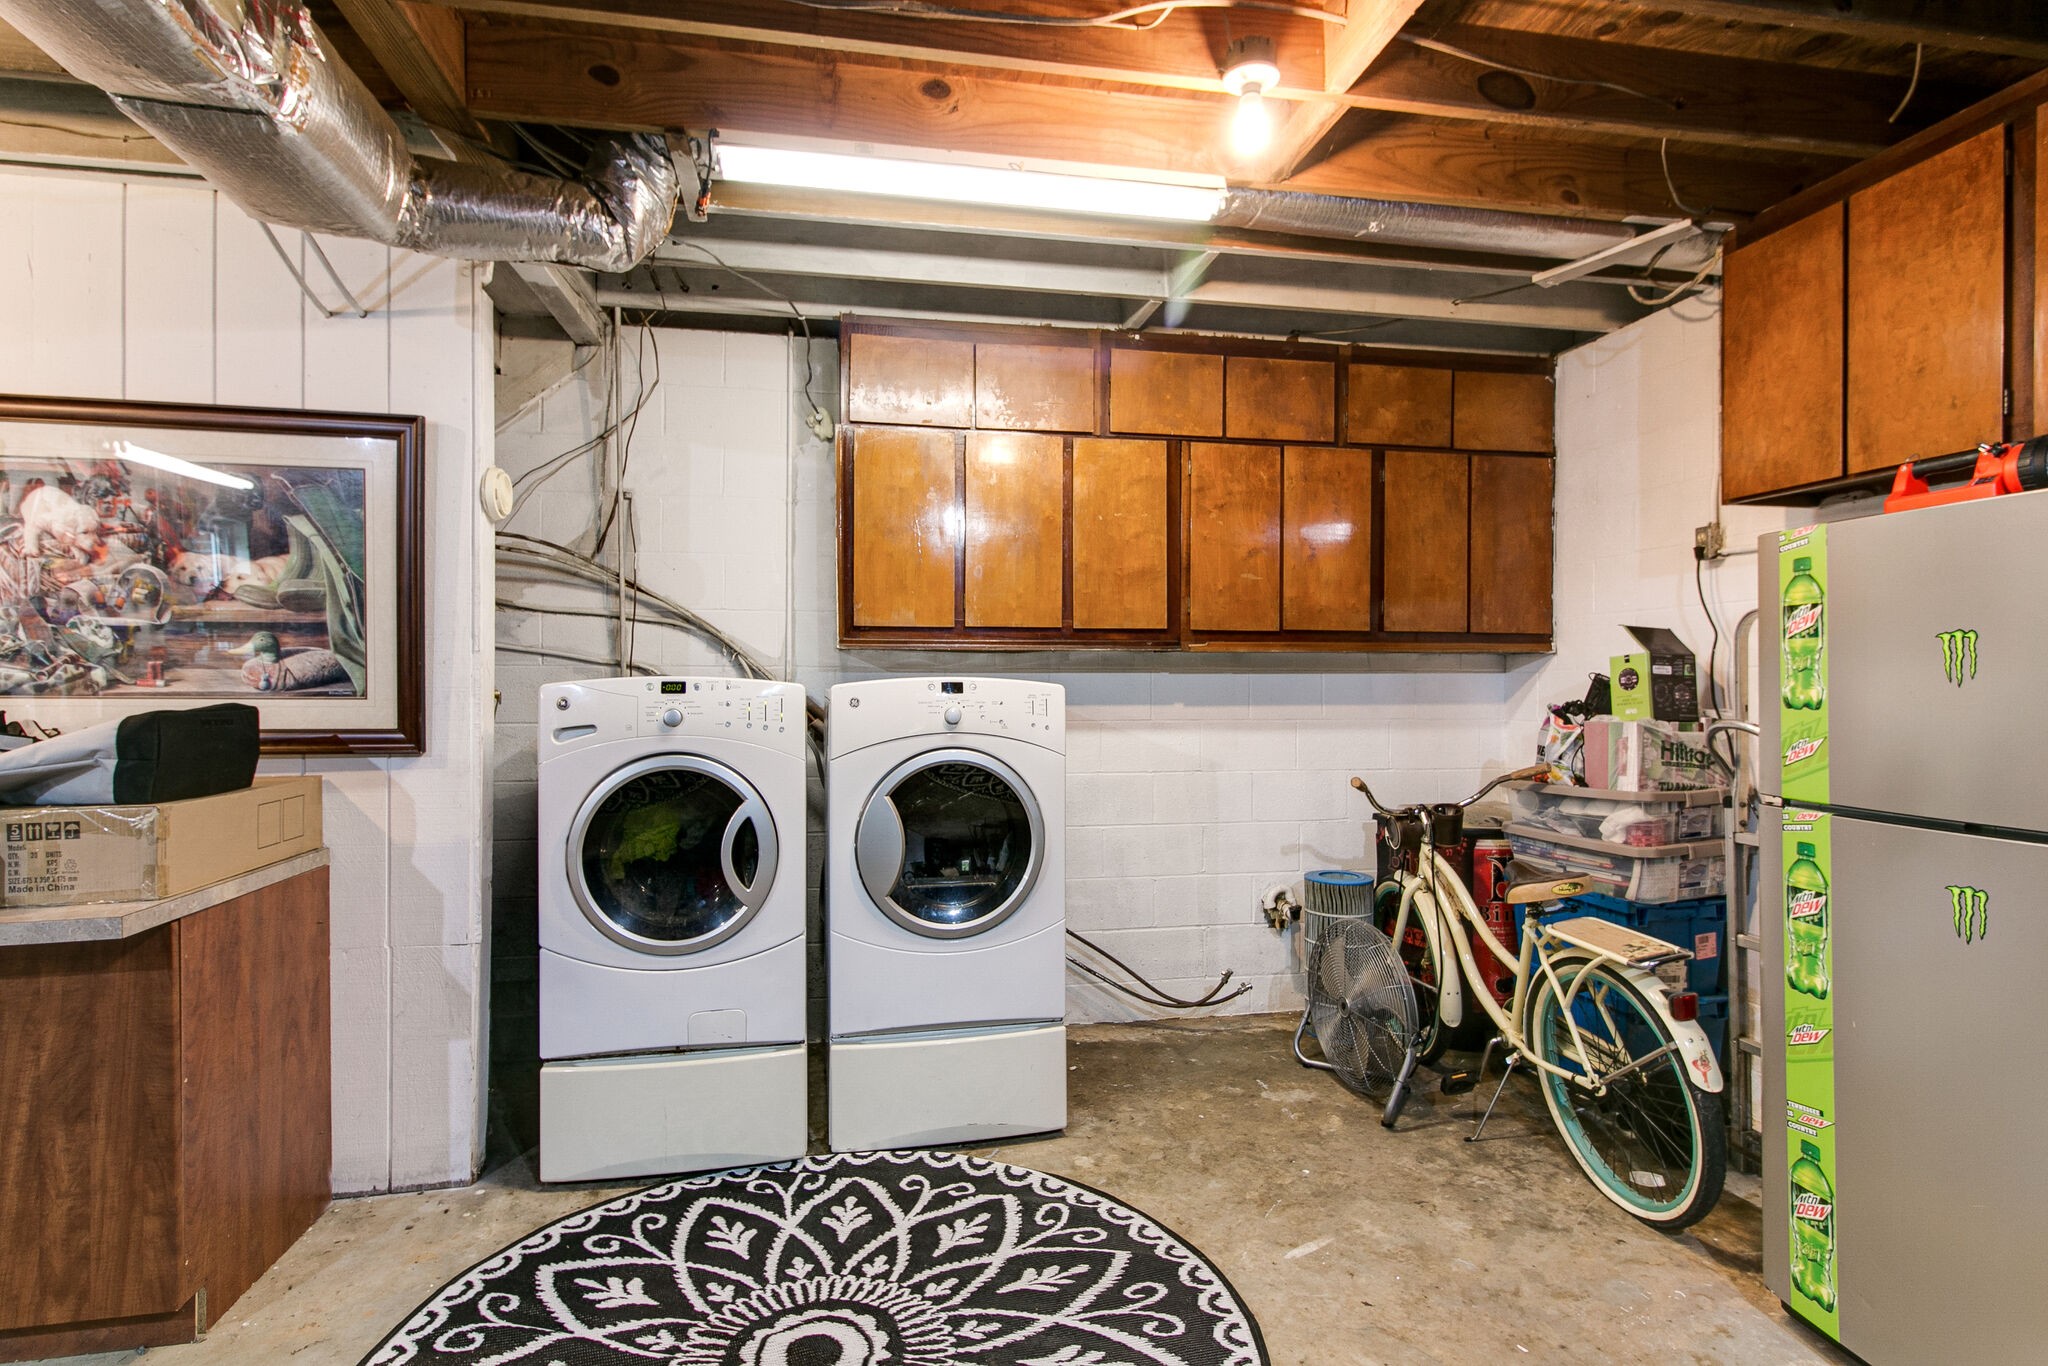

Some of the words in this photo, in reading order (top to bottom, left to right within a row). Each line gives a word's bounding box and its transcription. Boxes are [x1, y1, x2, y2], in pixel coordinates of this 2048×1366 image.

[1779, 538, 1809, 552] COUNTRY
[8, 885, 34, 894] Made
[35, 884, 45, 892] in
[47, 883, 75, 892] China
[1787, 1121, 1817, 1136] COUNTRY
